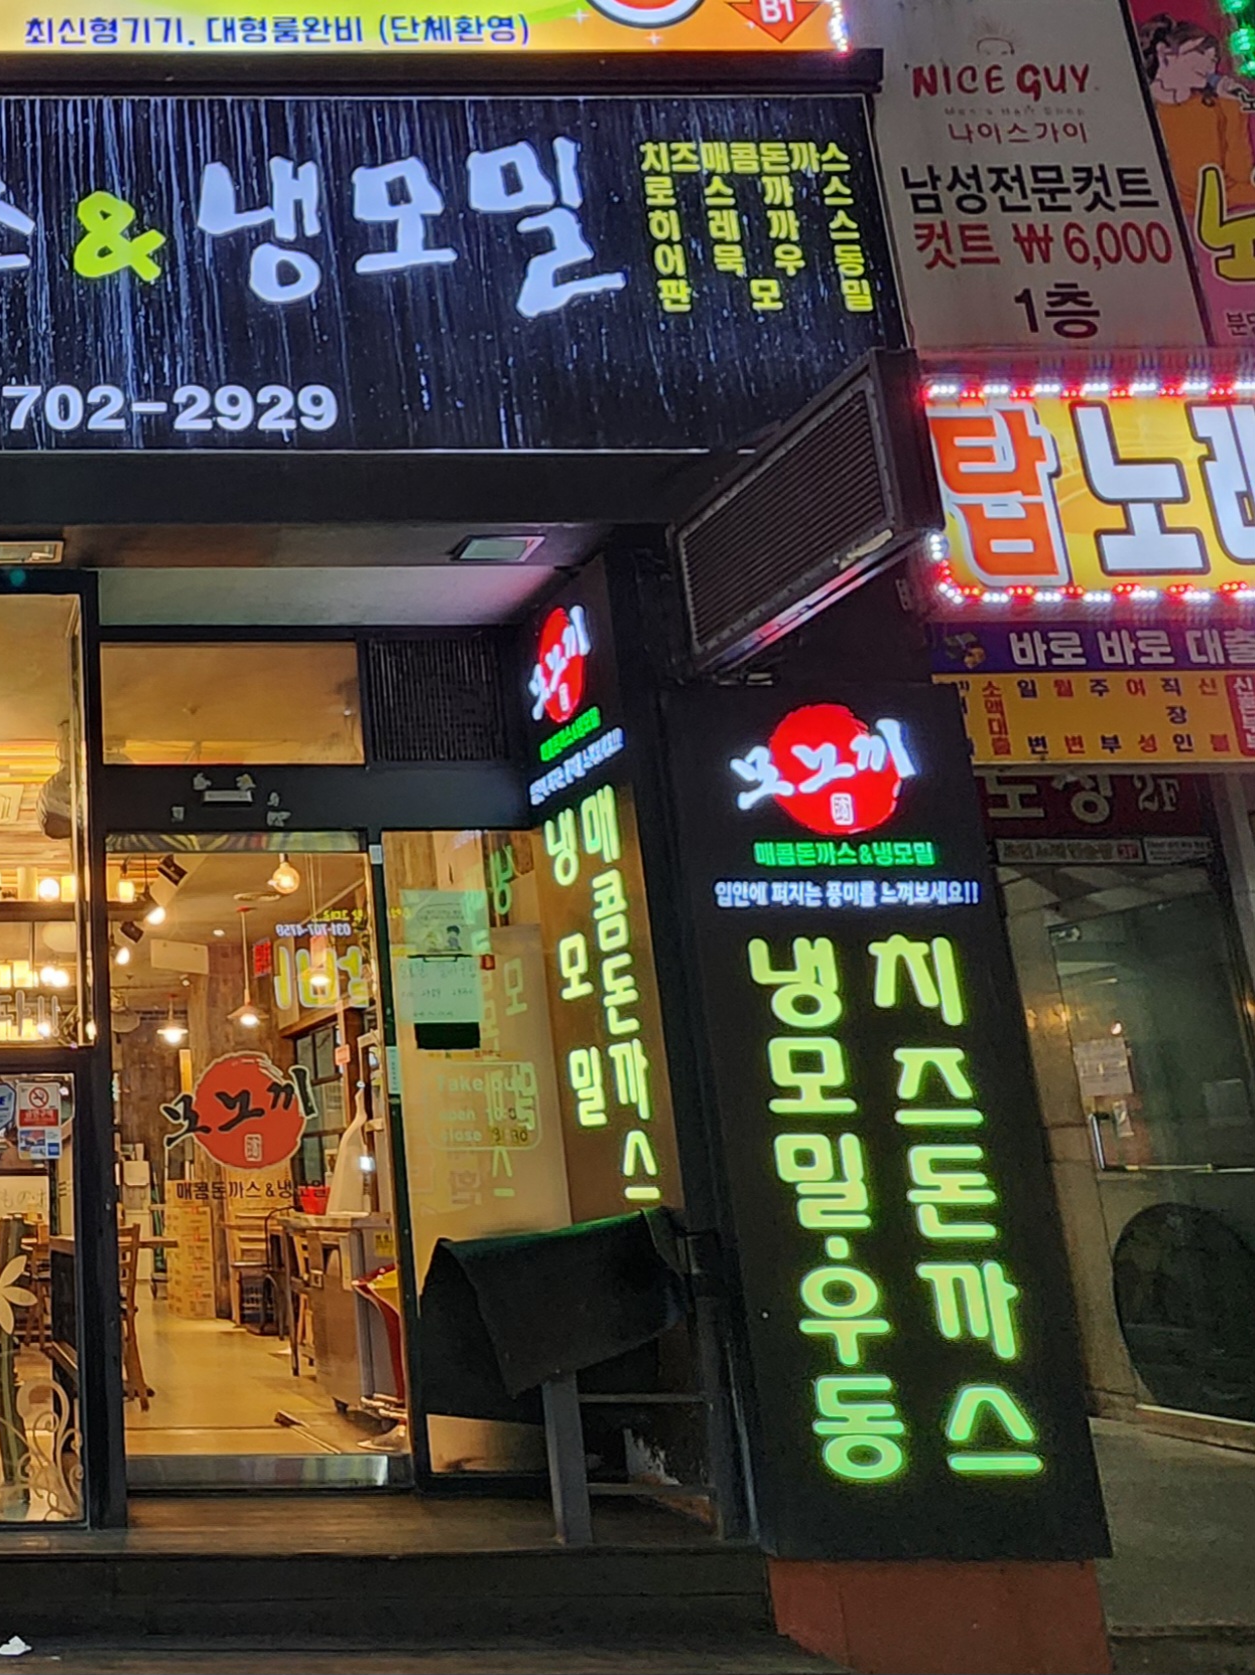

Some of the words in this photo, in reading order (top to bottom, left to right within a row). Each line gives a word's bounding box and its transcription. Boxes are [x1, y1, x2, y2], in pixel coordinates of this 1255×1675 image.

[25, 15, 195, 46] 최신형기기.
[206, 15, 363, 45] 대형룸완비
[378, 13, 530, 47] (단체환영)
[759, 0, 794, 24] B1
[912, 64, 1005, 99] NICE
[1016, 64, 1089, 101] GUY
[948, 122, 1088, 144] 나이스가이
[640, 142, 850, 173] 치즈매콤돈까스
[901, 164, 1160, 215] 남성전문컷트
[72, 190, 166, 282] &
[197, 136, 626, 318] 냉모밀
[913, 220, 1001, 270] 컷트
[1014, 282, 1101, 339] 1층
[2, 384, 339, 431] 702-2929
[1009, 631, 1087, 666] 바로
[1097, 629, 1175, 665] 바로
[1186, 628, 1255, 664] 대출
[715, 881, 768, 907] 입안에
[825, 881, 877, 907] 풍미를
[581, 784, 660, 1200] 매콤돈까스
[869, 933, 1043, 1474] 치즈돈까스
